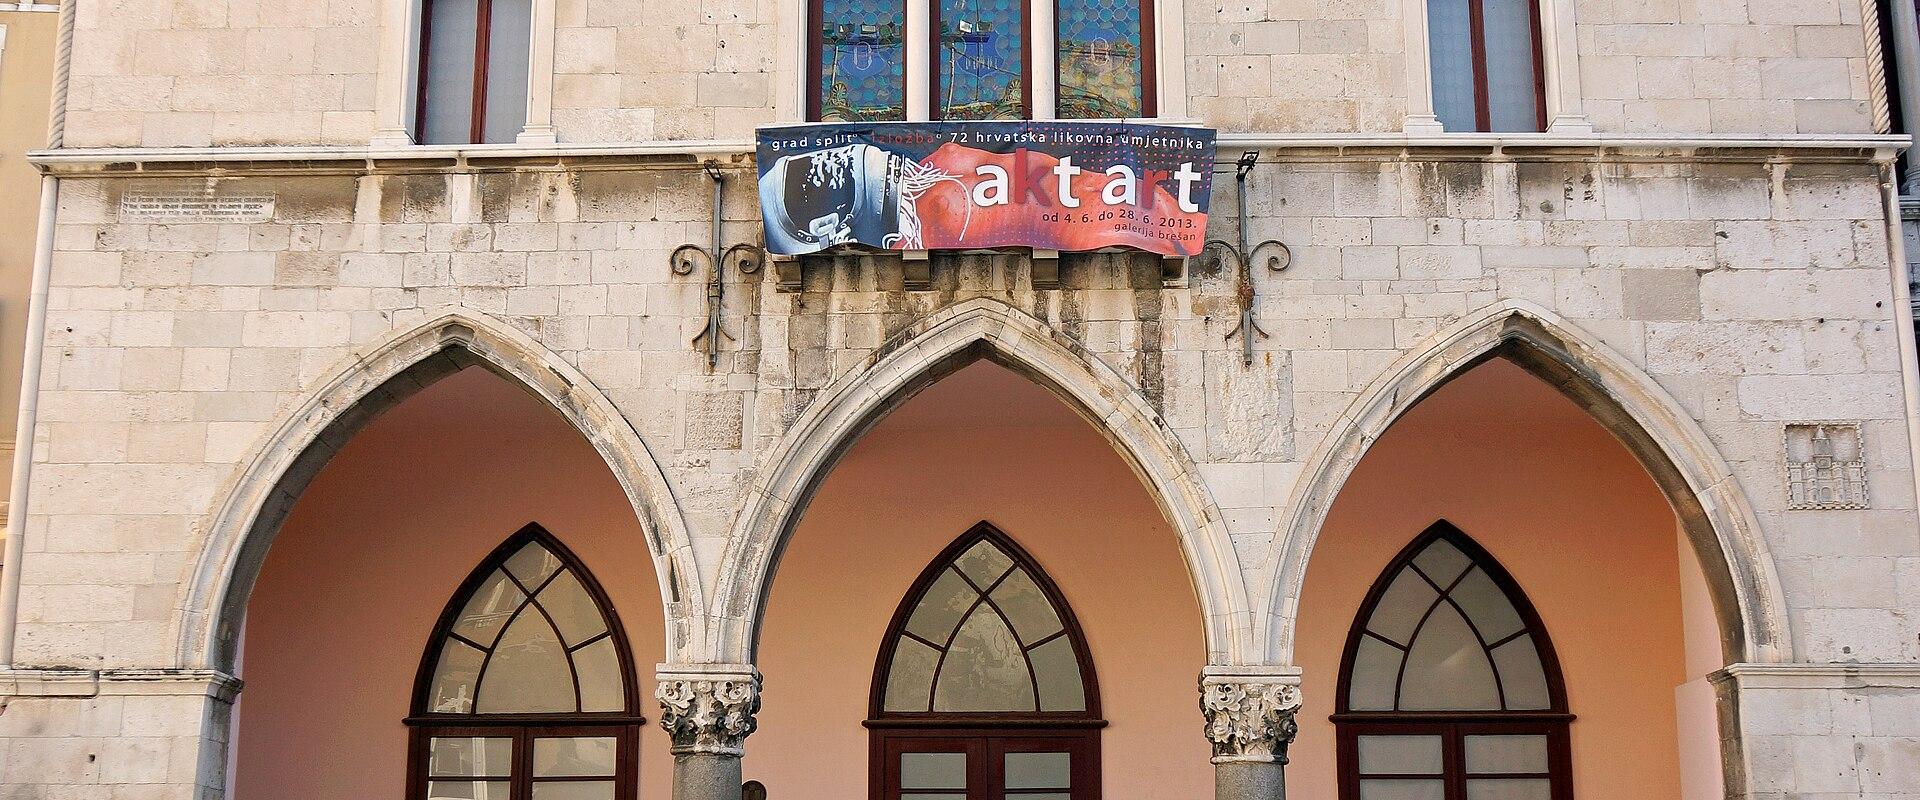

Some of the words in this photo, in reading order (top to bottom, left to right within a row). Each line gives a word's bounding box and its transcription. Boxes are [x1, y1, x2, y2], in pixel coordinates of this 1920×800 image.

[772, 137, 808, 151] grad
[816, 135, 852, 147] split
[950, 132, 968, 143] 72
[976, 131, 1046, 143] hrvatska
[1054, 131, 1113, 144] likovna
[1120, 134, 1203, 149] umjetnika
[972, 148, 1081, 208] akt
[1101, 162, 1202, 213] art
[1042, 213, 1059, 223] od
[1064, 213, 1077, 224] 4.
[1081, 213, 1094, 223] 6.
[1098, 211, 1114, 221] do
[1119, 209, 1139, 221] 28.
[1143, 215, 1154, 226] 6.
[1159, 217, 1197, 229] 2013.
[1114, 223, 1154, 238] galerija
[1158, 230, 1196, 241] brešan
